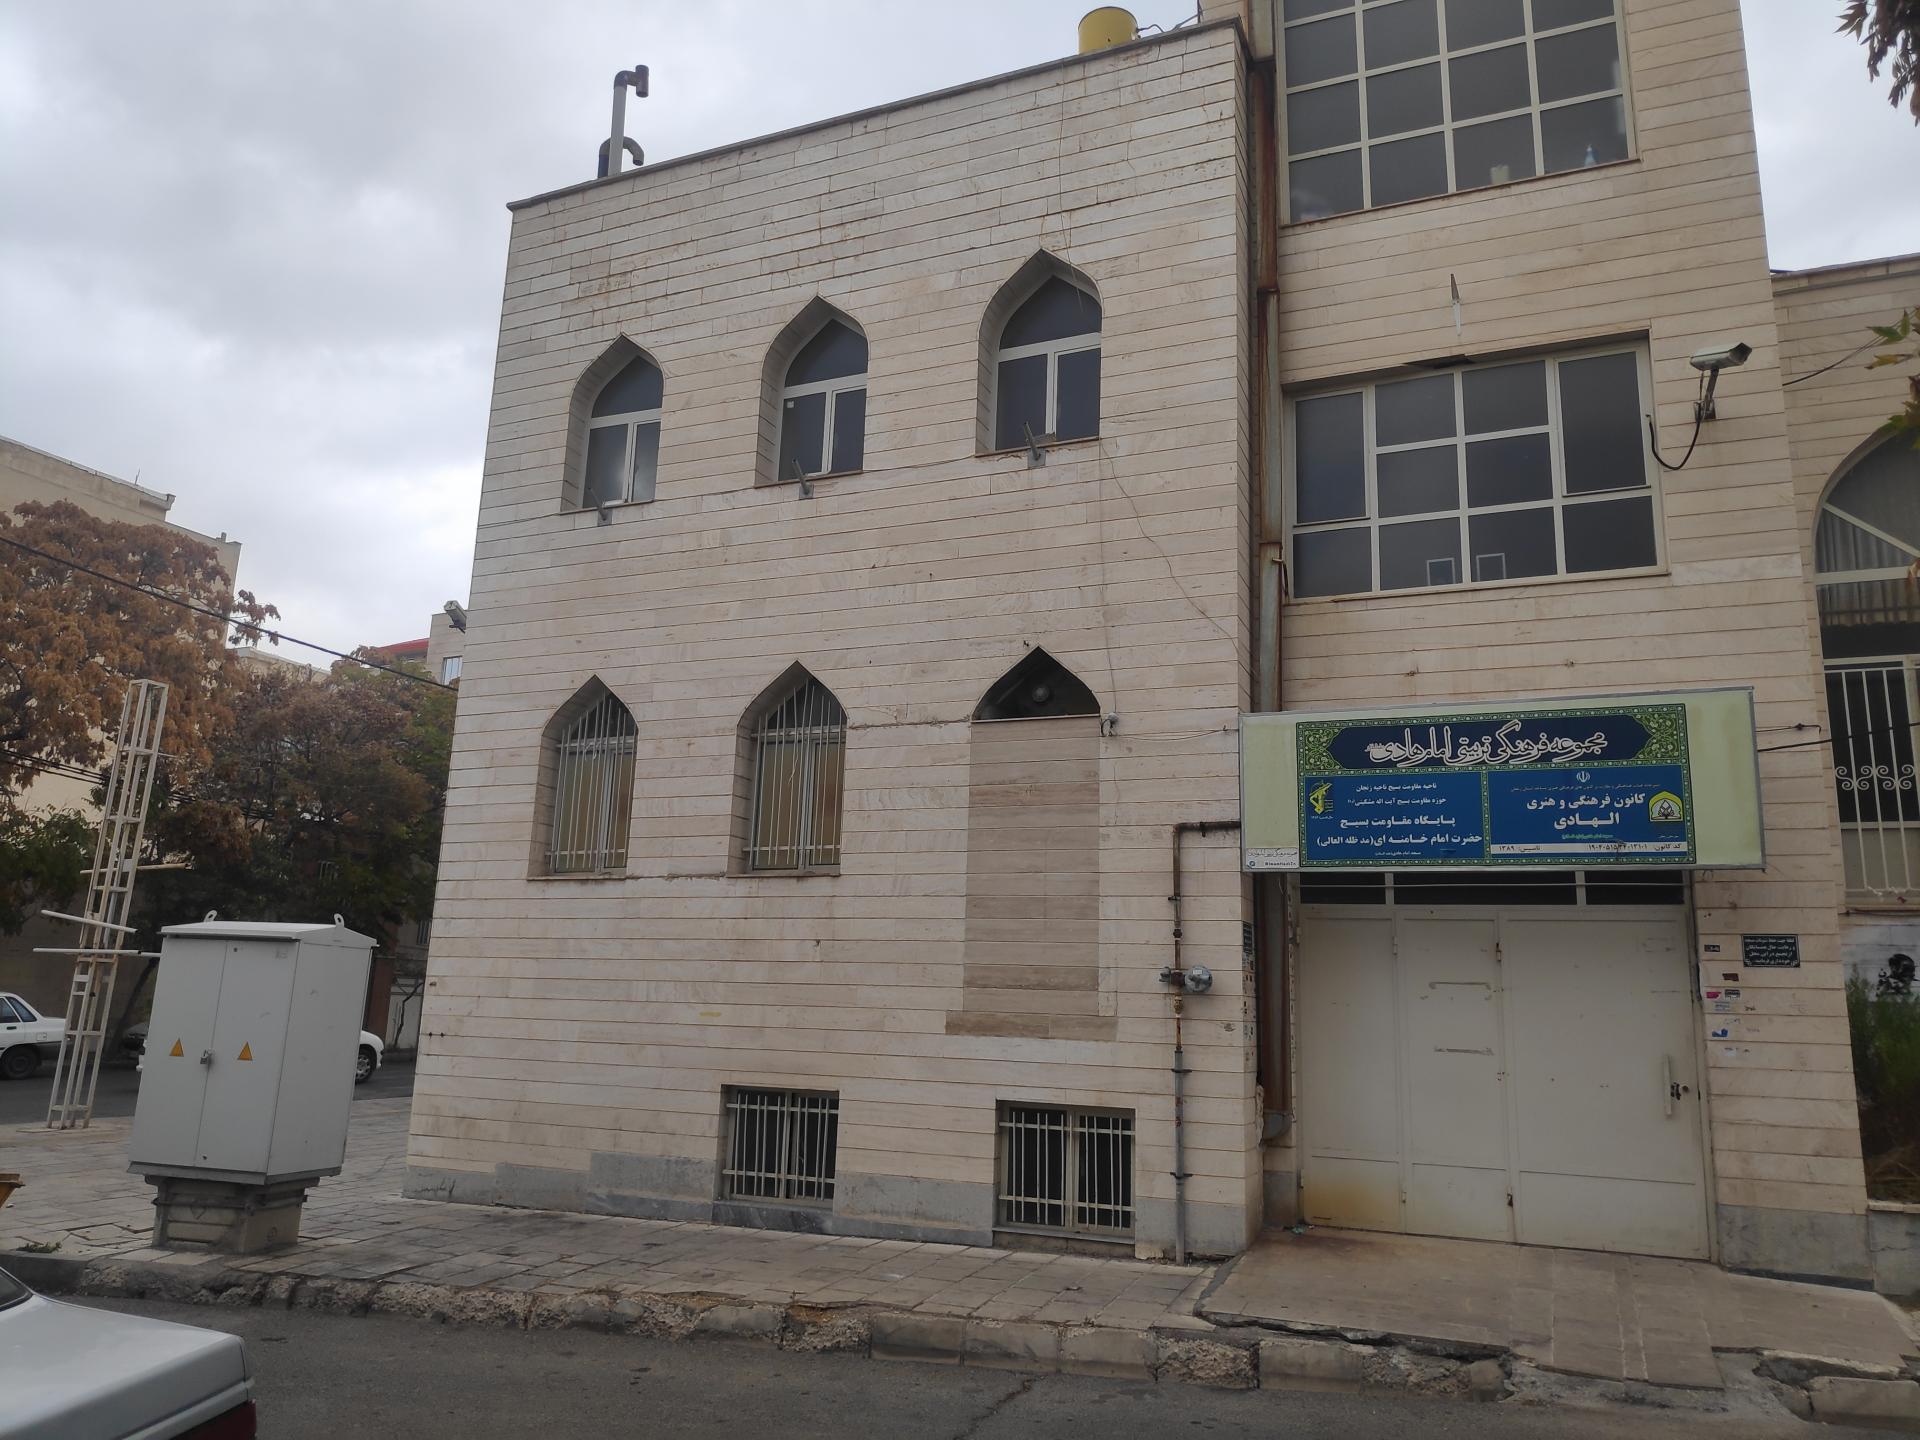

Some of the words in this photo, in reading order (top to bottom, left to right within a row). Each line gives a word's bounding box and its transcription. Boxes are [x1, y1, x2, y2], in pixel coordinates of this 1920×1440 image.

[1370, 728, 1425, 762] هادی
[1396, 726, 1451, 767] امام
[1485, 720, 1550, 763] فرهنگی
[1550, 732, 1608, 762] مجموعه
[1444, 736, 1491, 766] تربیتی
[1526, 797, 1555, 810] هنری
[1560, 799, 1566, 809] و
[1569, 794, 1610, 809] فرهنگی
[1614, 793, 1645, 807] کانون
[1340, 818, 1369, 829] بسیج
[1371, 816, 1412, 828] مقاومت
[1415, 815, 1455, 827] پایگاه
[1554, 812, 1619, 829] الهادی
[1388, 834, 1428, 844] خامنه
[1431, 834, 1449, 845] امام
[1451, 833, 1482, 846] حضرت
